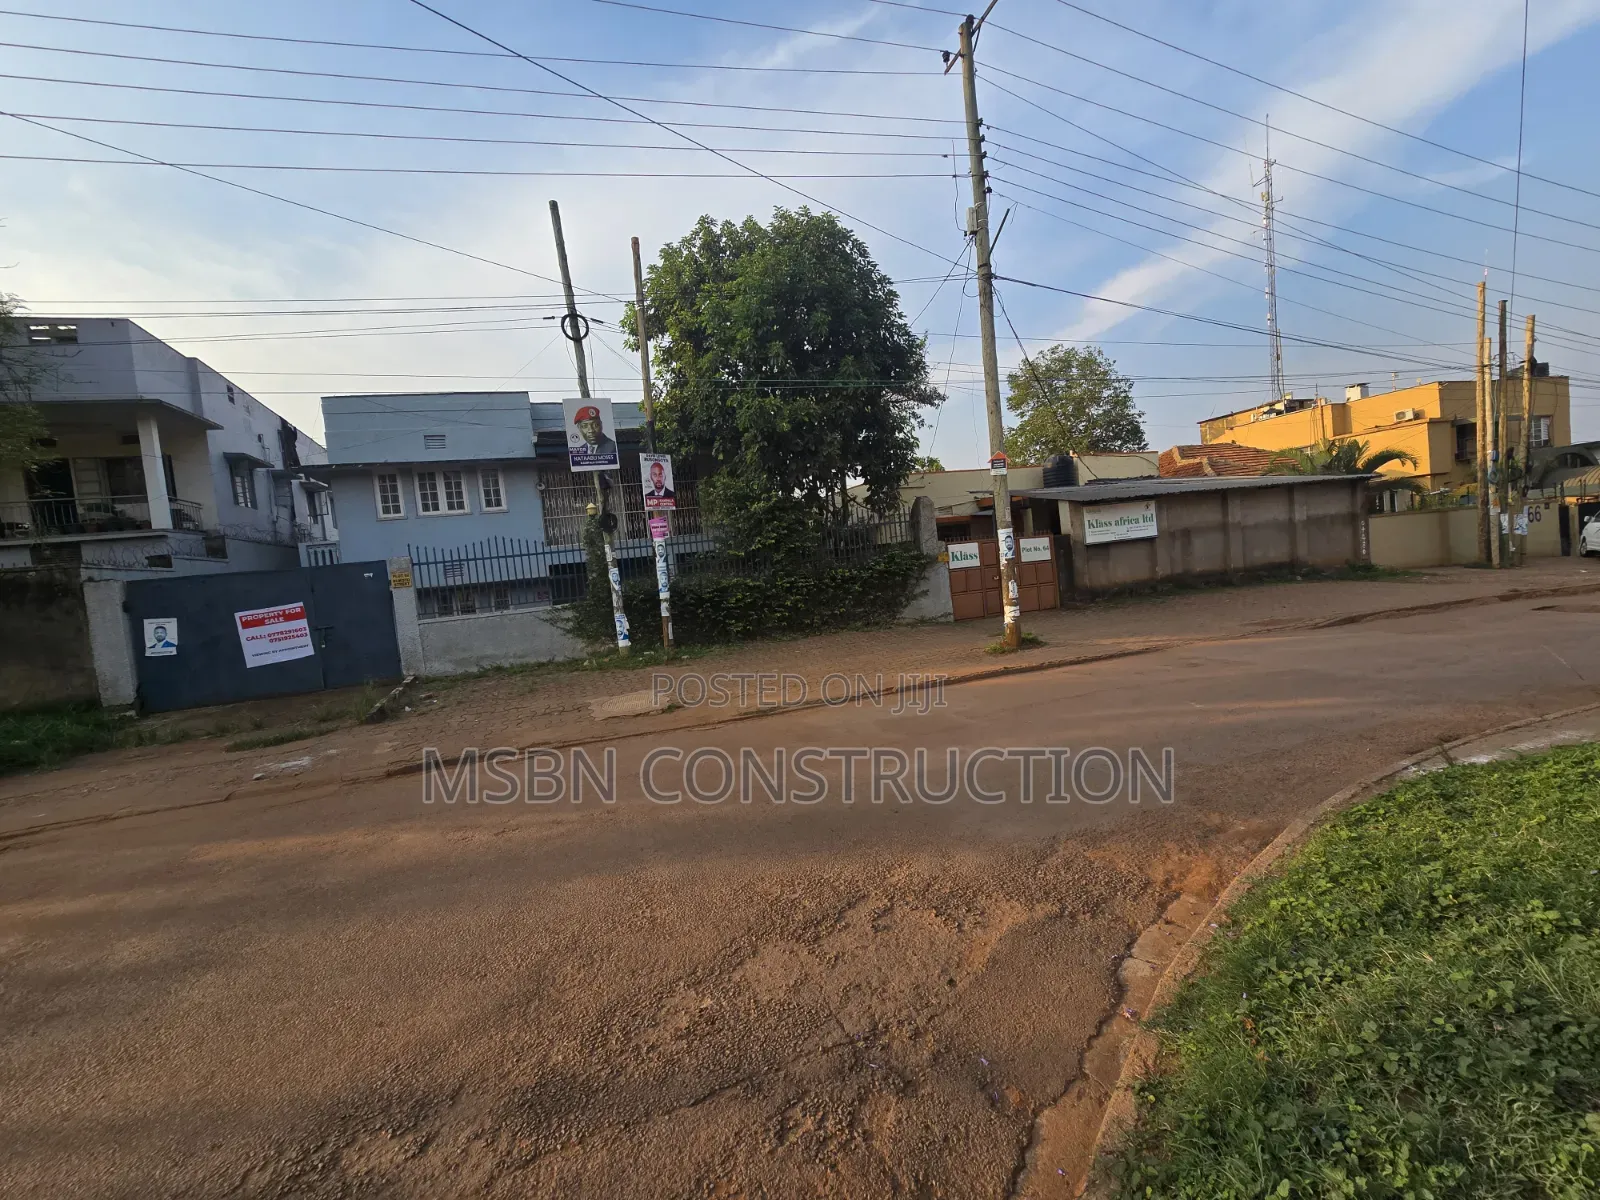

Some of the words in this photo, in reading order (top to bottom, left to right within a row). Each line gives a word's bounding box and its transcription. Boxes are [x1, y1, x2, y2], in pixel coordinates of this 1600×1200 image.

[646, 498, 658, 506] MP
[1114, 515, 1140, 526] africa
[1142, 513, 1154, 523] ltd
[1527, 505, 1541, 523] 66
[241, 610, 284, 622] PROPERTY
[285, 607, 301, 615] FOR
[264, 616, 285, 625] SALE
[245, 634, 267, 642] CALL:
